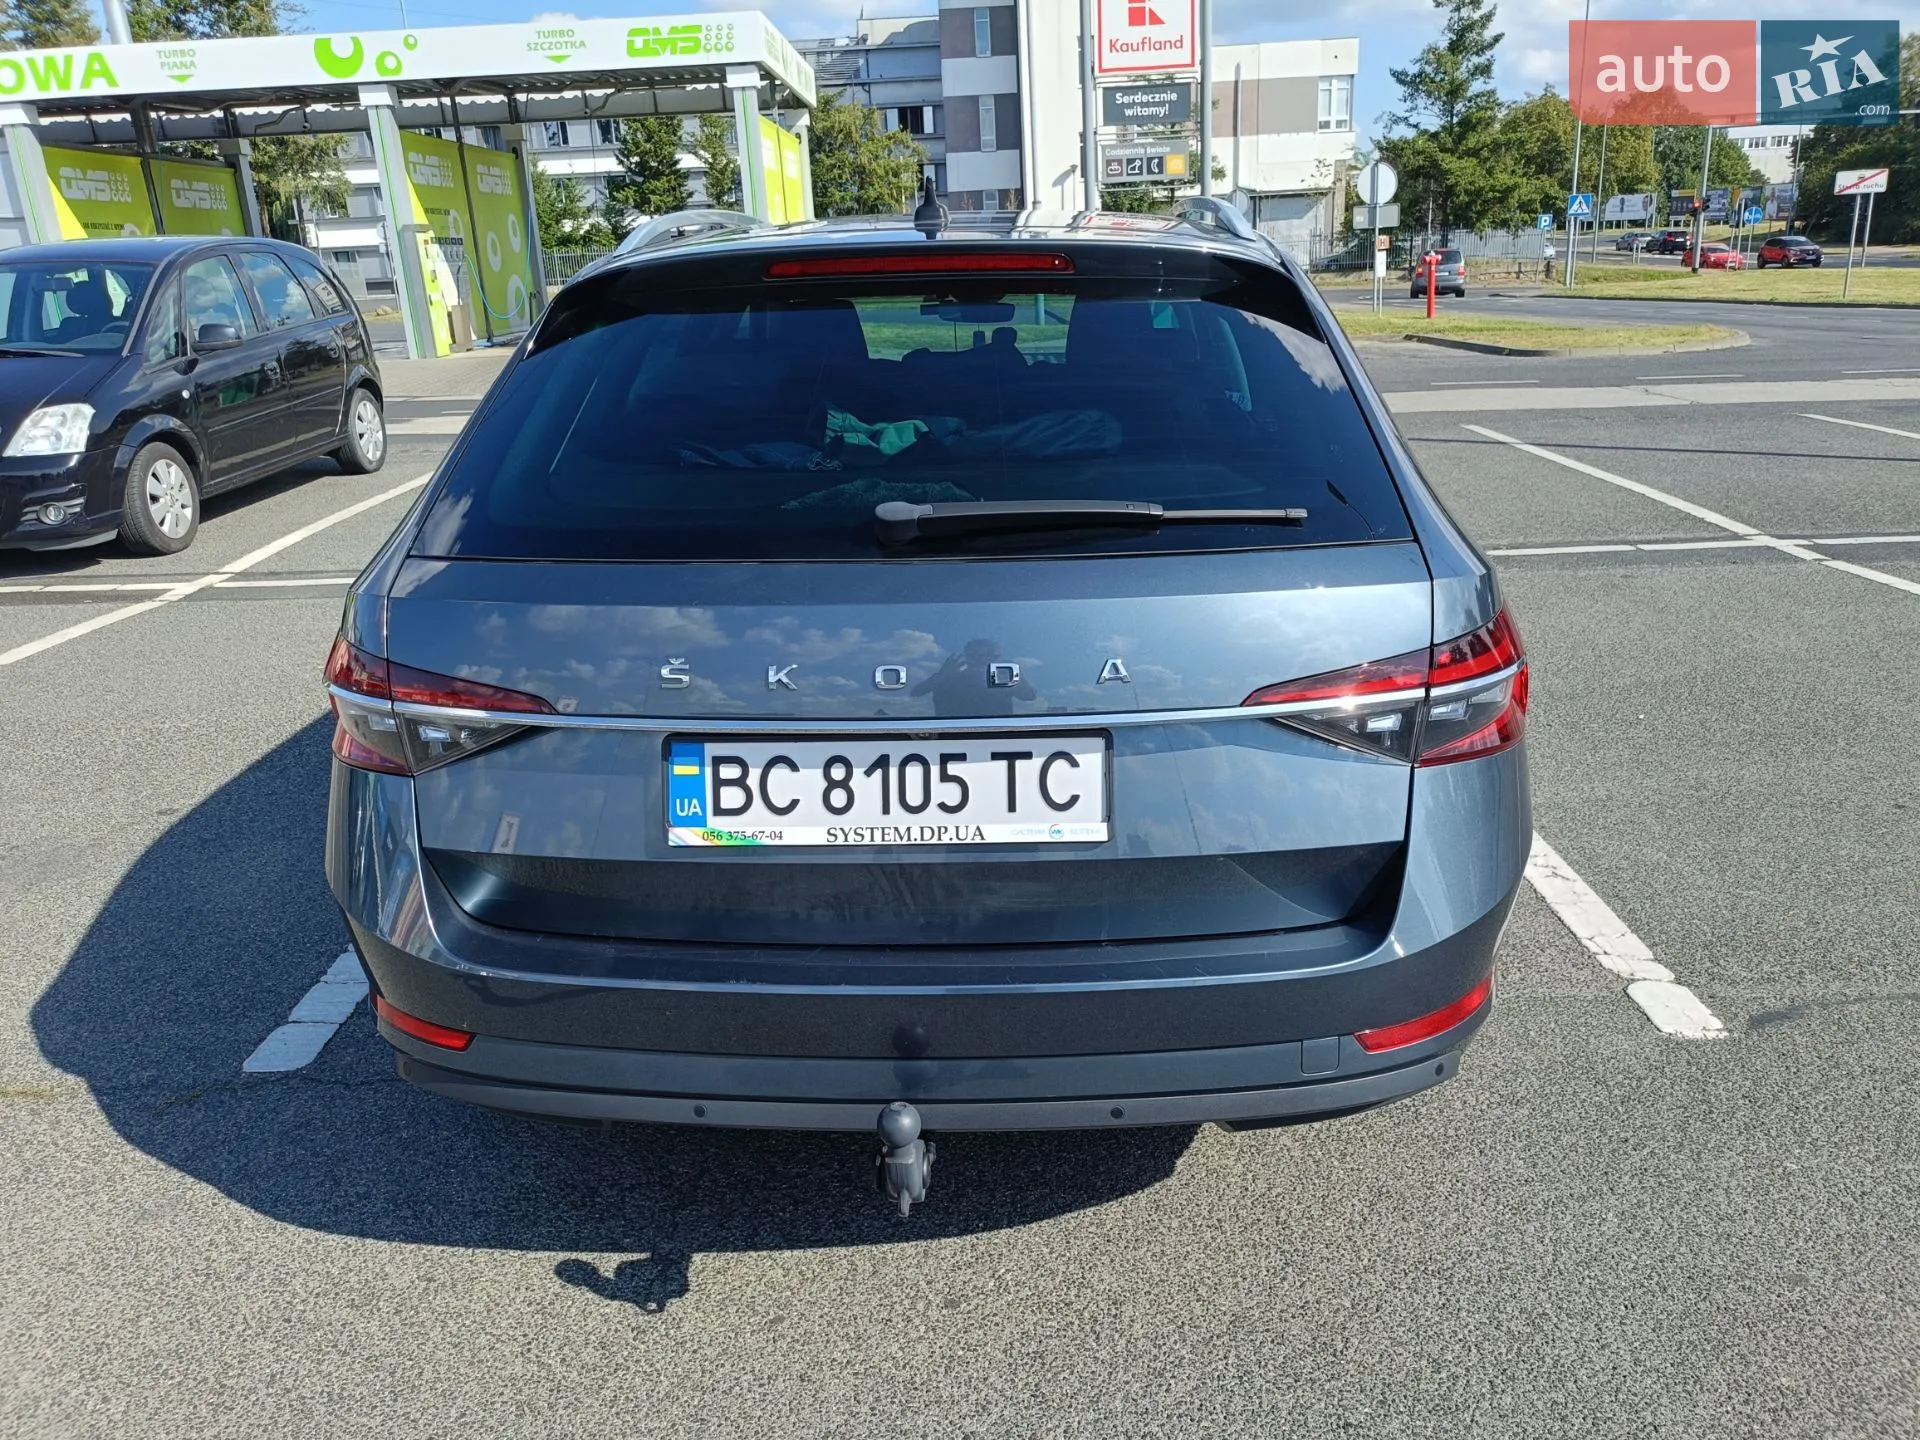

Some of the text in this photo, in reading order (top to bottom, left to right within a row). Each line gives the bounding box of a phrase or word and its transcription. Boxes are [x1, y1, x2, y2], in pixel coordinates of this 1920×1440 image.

[535, 29, 576, 39] TURBO
[526, 40, 587, 51] SZCZOTKA
[1109, 35, 1184, 53] Kaufland
[156, 49, 196, 59] TURBO
[160, 60, 197, 70] PIANA
[1115, 90, 1178, 104] Serdecznie
[1124, 104, 1170, 118] witamy!
[660, 657, 1132, 691] ŠKODA
[676, 750, 1081, 817] UA BC 8105 TC
[702, 829, 784, 842] 056 375-67-04
[826, 825, 986, 844] SYSTEM.DP.UA
